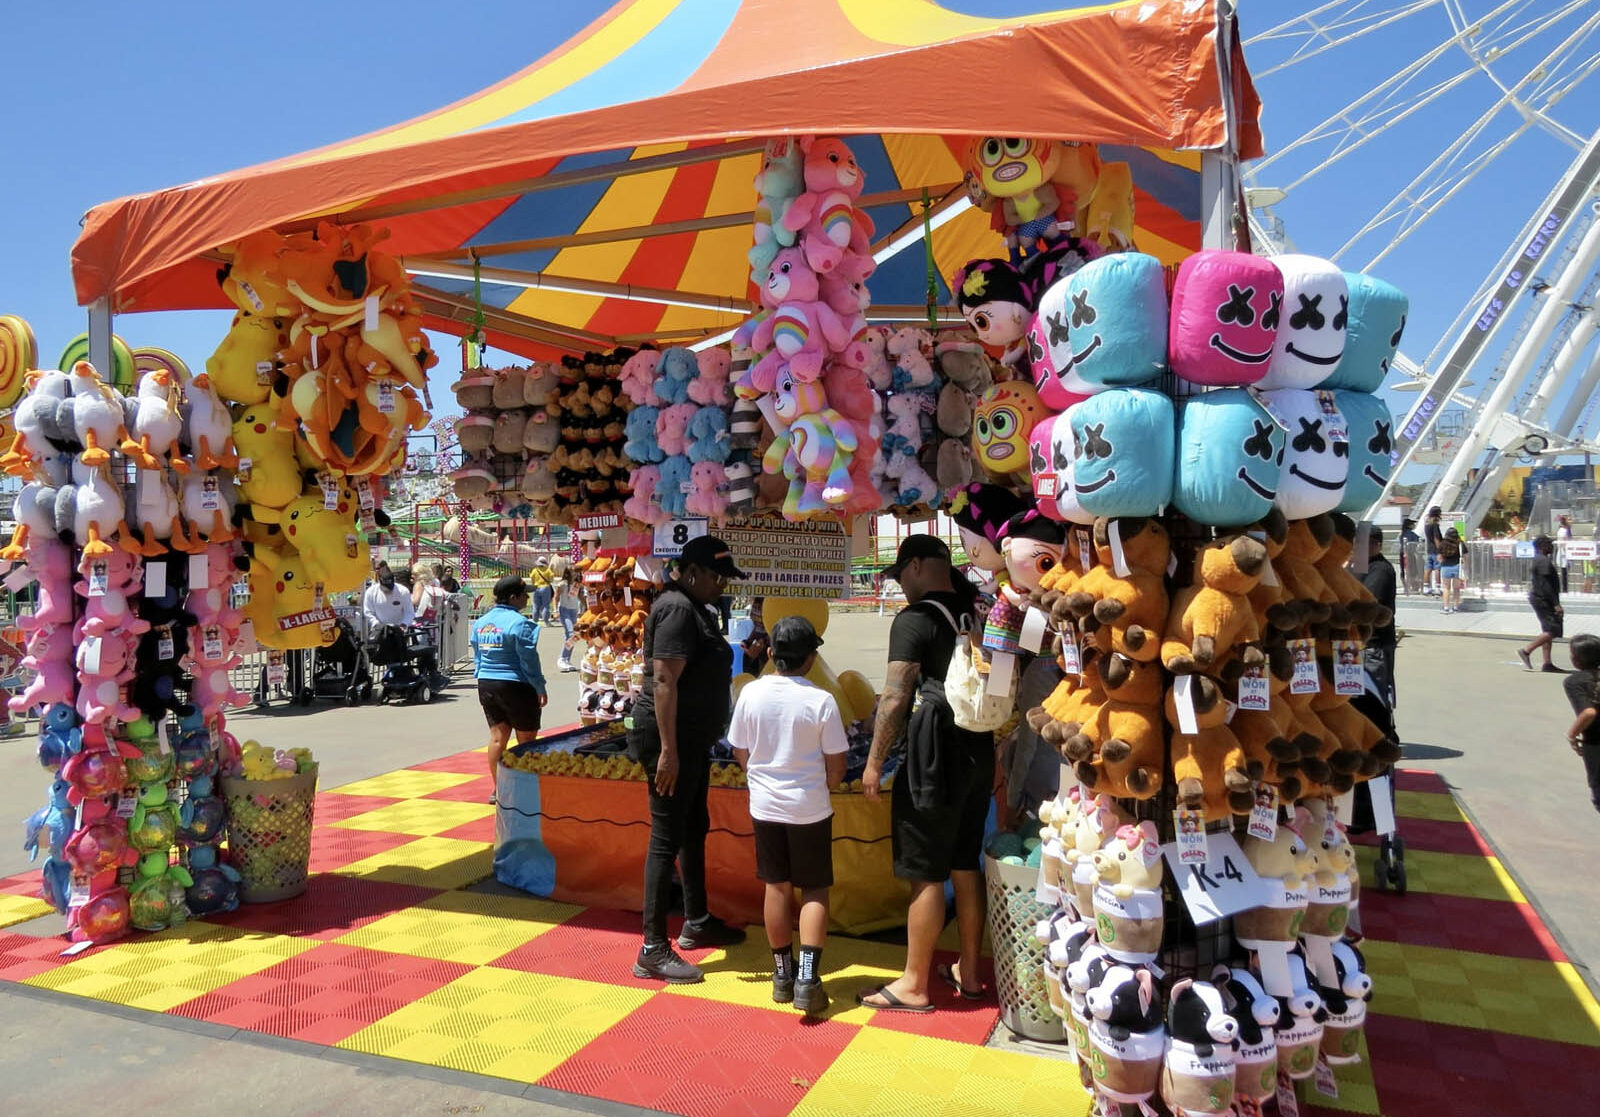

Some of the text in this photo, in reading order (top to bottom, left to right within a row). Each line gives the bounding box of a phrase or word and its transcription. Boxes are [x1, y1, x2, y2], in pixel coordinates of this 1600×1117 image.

[1477, 298, 1503, 331] LETS
[1507, 270, 1522, 288] GO
[579, 515, 618, 529] MEDIUM
[673, 524, 689, 545] 8
[710, 531, 739, 541] PICK
[742, 533, 758, 543] UP
[769, 534, 801, 545] DUCK
[803, 536, 818, 546] TO
[821, 537, 845, 547] WIN
[741, 546, 753, 556] ON
[755, 547, 780, 557] DUCK
[789, 549, 808, 558] SIZE
[820, 550, 845, 560] PRIZE
[755, 572, 773, 582] FOR
[775, 573, 810, 584] LARGER
[813, 575, 844, 585] PRIZES
[746, 585, 753, 595] 1
[755, 585, 788, 596] DUCK
[790, 586, 813, 597] PER
[815, 587, 843, 599] PLAY
[283, 609, 333, 629] X-LARGE
[1337, 667, 1360, 675] WON
[1242, 680, 1265, 689] WON
[1253, 807, 1274, 820] WON
[1181, 835, 1203, 844] WON
[1190, 856, 1243, 892] K-4
